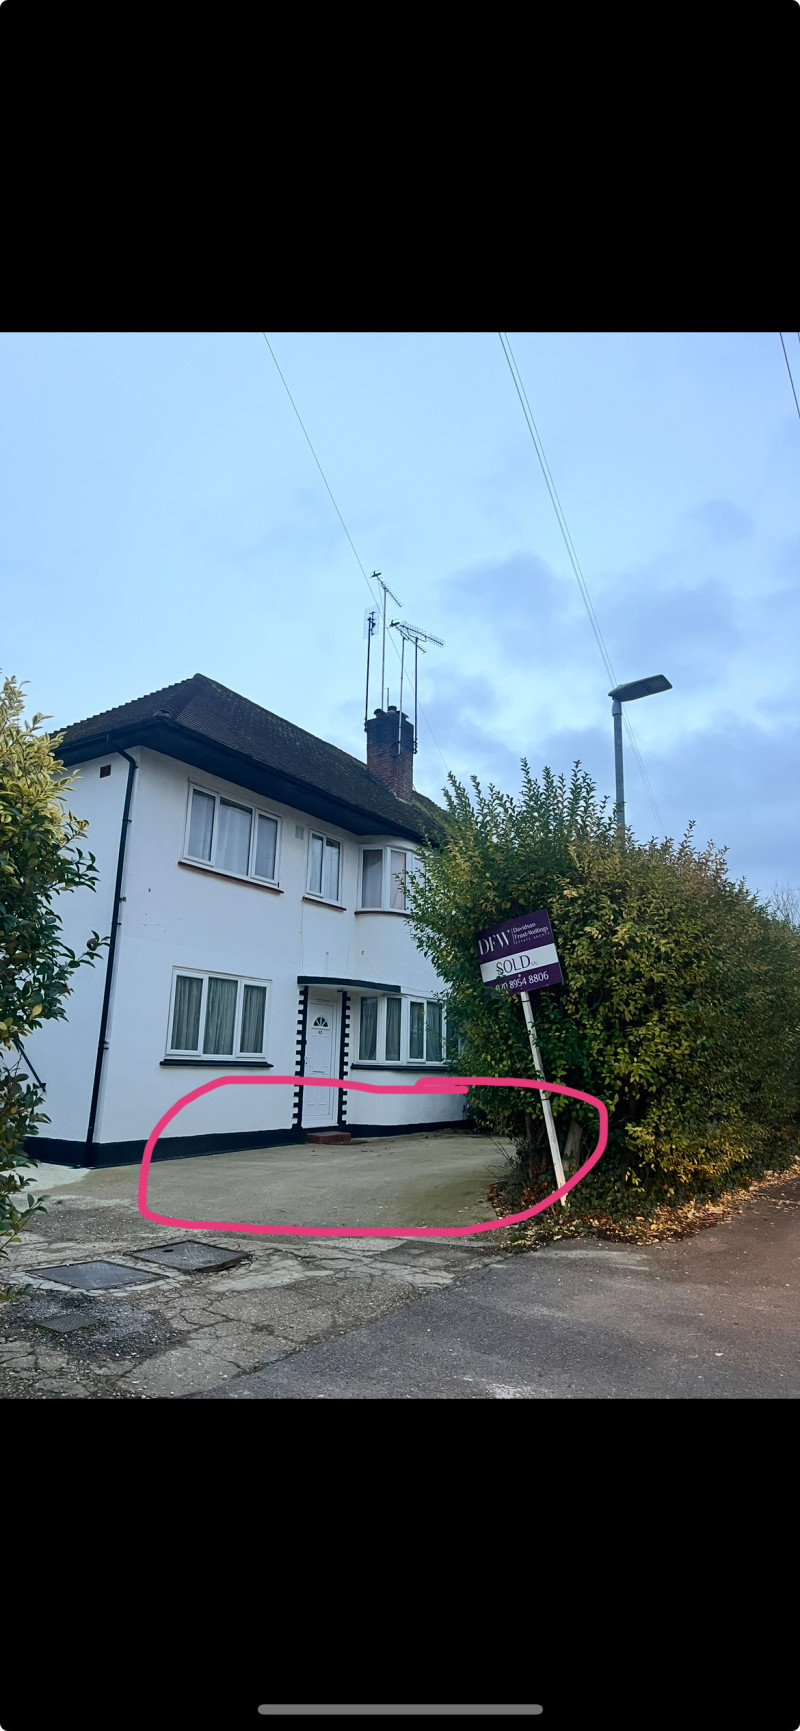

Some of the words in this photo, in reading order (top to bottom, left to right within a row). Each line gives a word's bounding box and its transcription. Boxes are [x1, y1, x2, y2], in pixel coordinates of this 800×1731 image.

[514, 922, 536, 933] Davidson
[478, 929, 511, 955] DFW
[496, 955, 531, 975] SOLD
[509, 977, 527, 989] 8954
[528, 970, 549, 984] 8806
